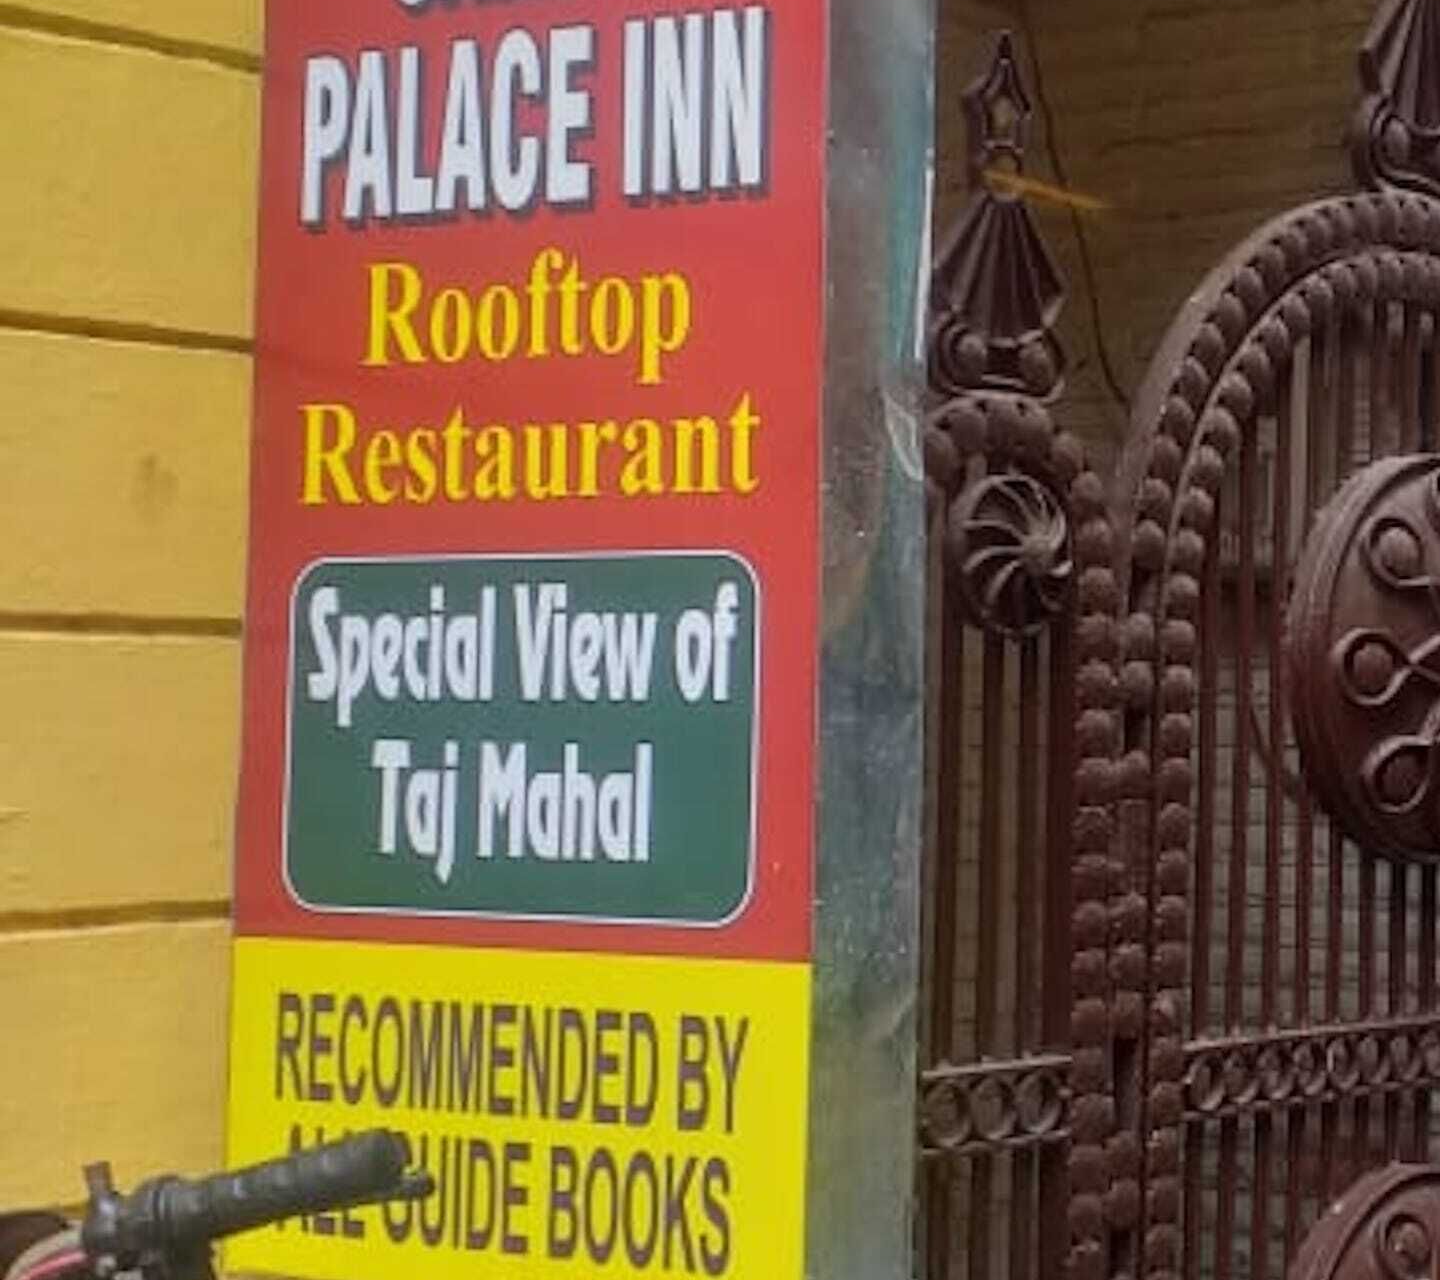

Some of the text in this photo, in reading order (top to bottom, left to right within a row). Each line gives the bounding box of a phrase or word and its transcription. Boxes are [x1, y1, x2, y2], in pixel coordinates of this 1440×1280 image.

[300, 4, 768, 226] PALACE INN
[360, 246, 693, 385] Rooftop
[299, 389, 762, 506] Restaurant
[306, 579, 739, 728] Special View of
[370, 737, 654, 885] Taj Mahal
[274, 991, 751, 1135] RECOMMENDED BY
[382, 1131, 530, 1256] GUIDE
[547, 1143, 732, 1278] BOOKS
